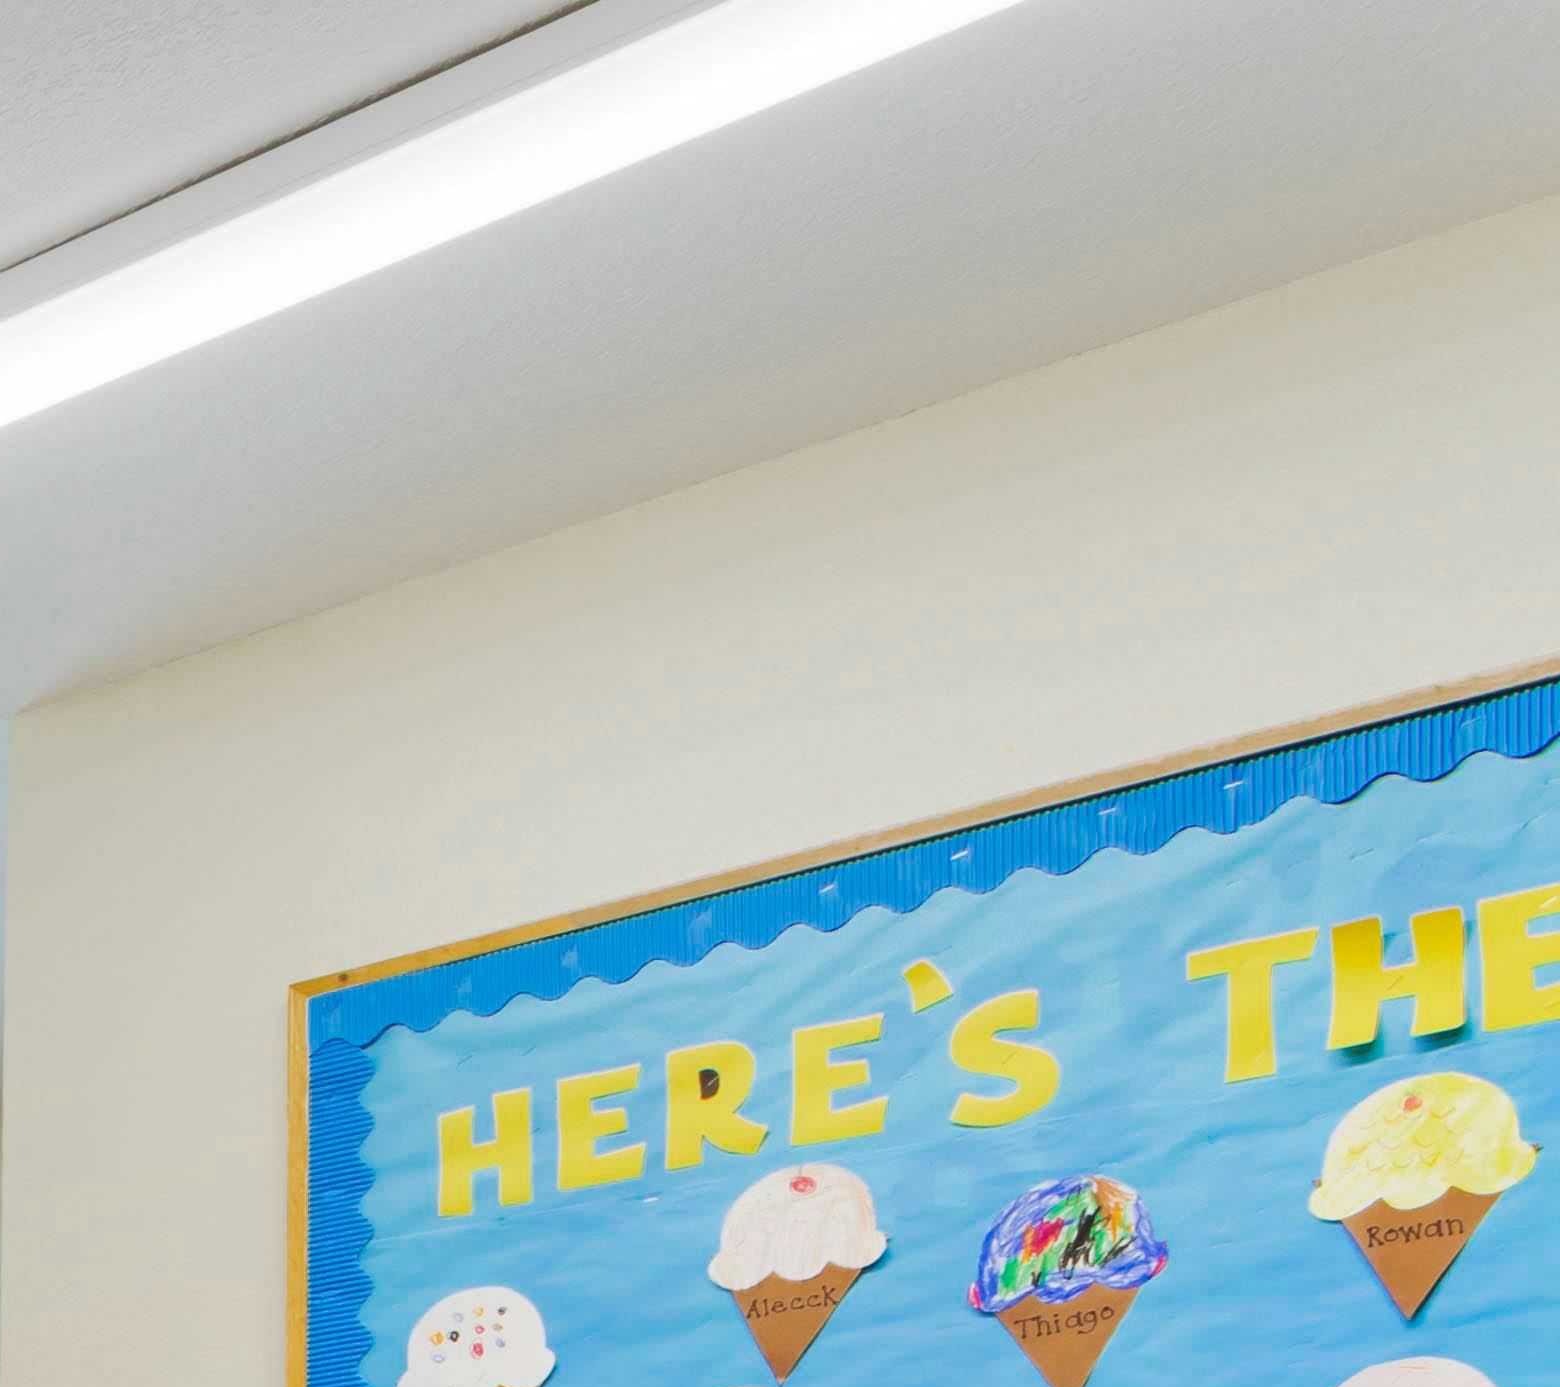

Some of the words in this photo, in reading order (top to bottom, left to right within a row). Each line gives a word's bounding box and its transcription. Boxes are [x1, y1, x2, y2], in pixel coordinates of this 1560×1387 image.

[438, 957, 1060, 1217] HERE'S
[1184, 880, 1560, 1085] THE
[1366, 1215, 1466, 1248] Rowan
[1014, 1303, 1116, 1342] Thiago
